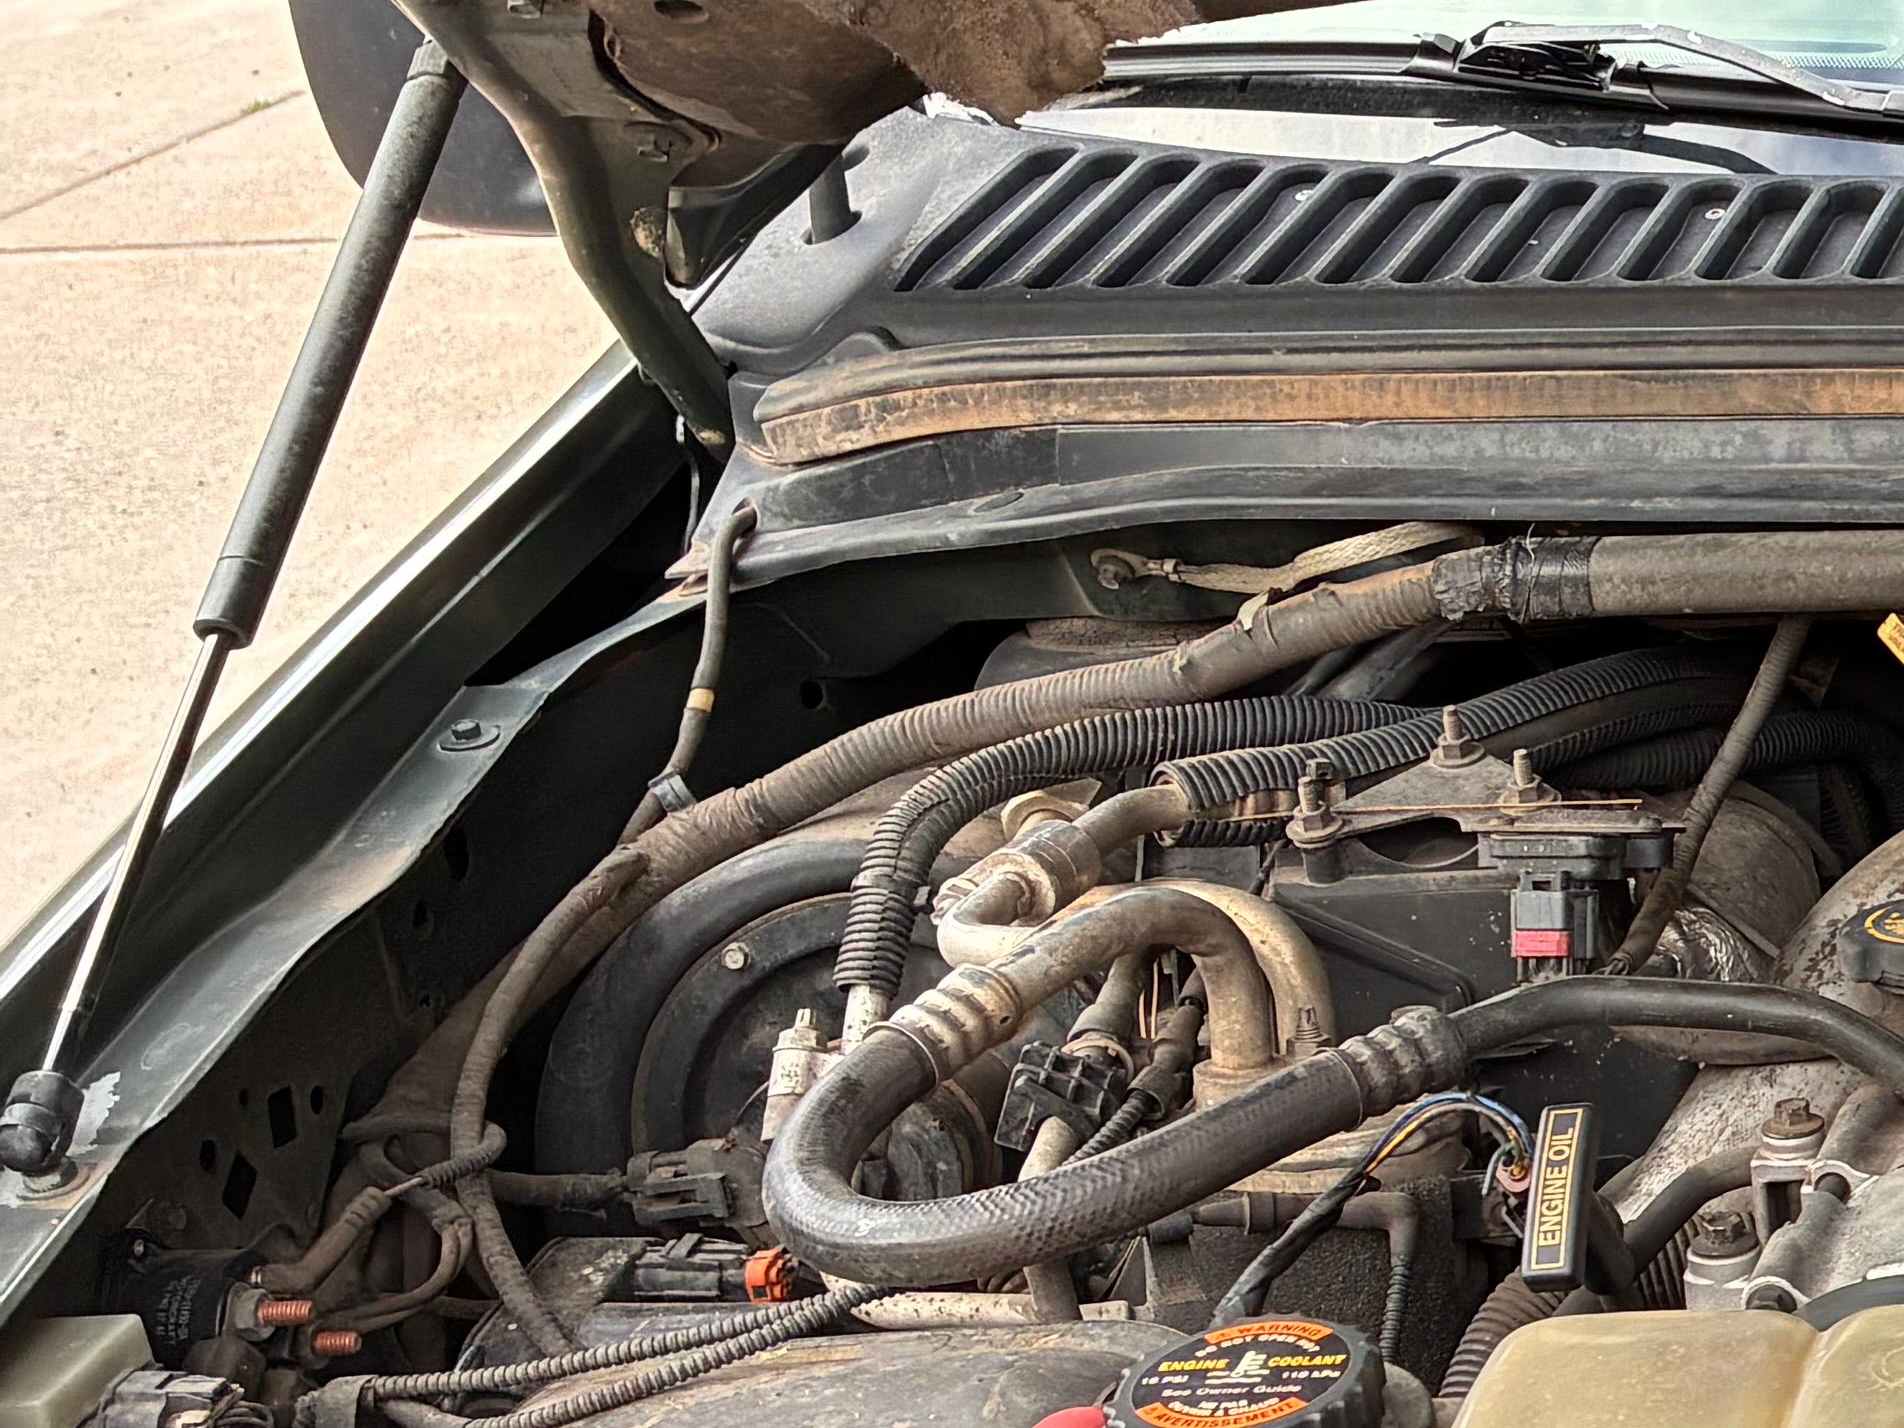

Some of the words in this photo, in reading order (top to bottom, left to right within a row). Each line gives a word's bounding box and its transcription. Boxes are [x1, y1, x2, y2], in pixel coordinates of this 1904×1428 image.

[1548, 1127, 1574, 1162] OIL
[1538, 1165, 1567, 1247] ENGINE
[1237, 1323, 1323, 1337] WARNING
[1220, 1335, 1256, 1349] NOT
[1157, 1358, 1230, 1372] ENGINE
[1267, 1354, 1347, 1368] COOLANT
[1161, 1388, 1193, 1397] See
[1196, 1386, 1250, 1396] Owner
[1253, 1384, 1303, 1394] Guide
[1156, 1402, 1295, 1428] AVERTISSEMENT
